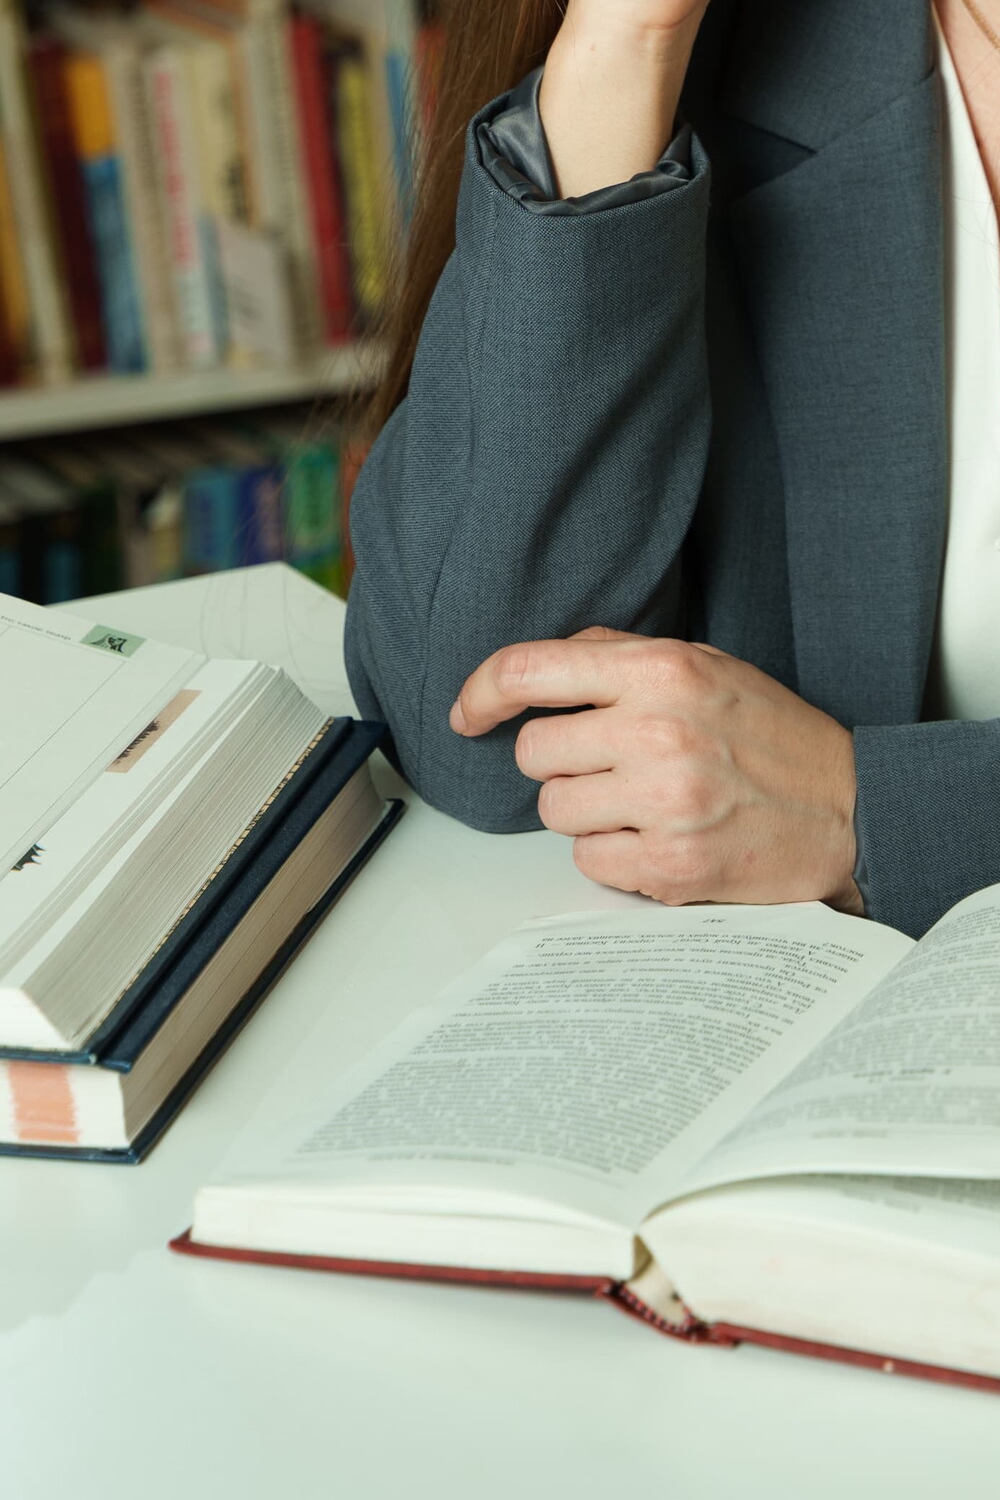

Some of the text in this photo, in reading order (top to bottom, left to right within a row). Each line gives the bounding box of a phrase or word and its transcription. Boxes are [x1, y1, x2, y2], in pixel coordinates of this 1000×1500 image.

[731, 933, 788, 944] что-нибудь
[719, 948, 762, 957] пределы
[765, 942, 803, 952] далеко
[822, 942, 863, 959] восток?
[825, 947, 858, 963] знаете
[717, 959, 775, 971] продолжит
[809, 957, 847, 973] молвил
[704, 969, 752, 979] случится
[711, 981, 787, 1000] возвращением
[786, 990, 814, 1003] твоих
